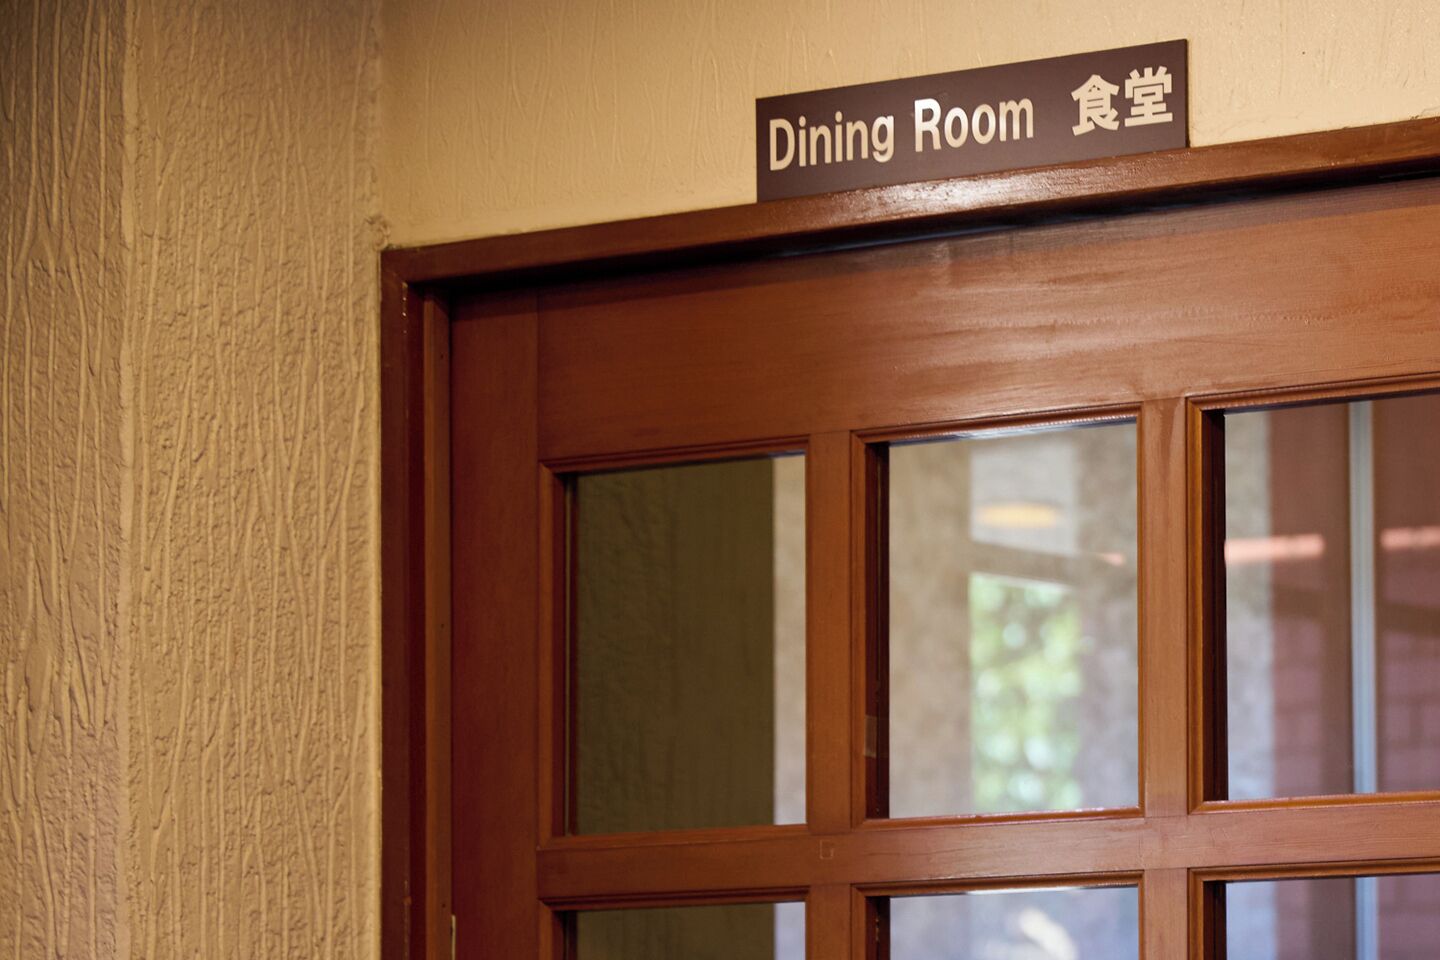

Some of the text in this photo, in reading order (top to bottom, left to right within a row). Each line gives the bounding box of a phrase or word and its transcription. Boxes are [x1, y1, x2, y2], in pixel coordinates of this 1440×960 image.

[768, 65, 1173, 171] Dining Room 食堂
